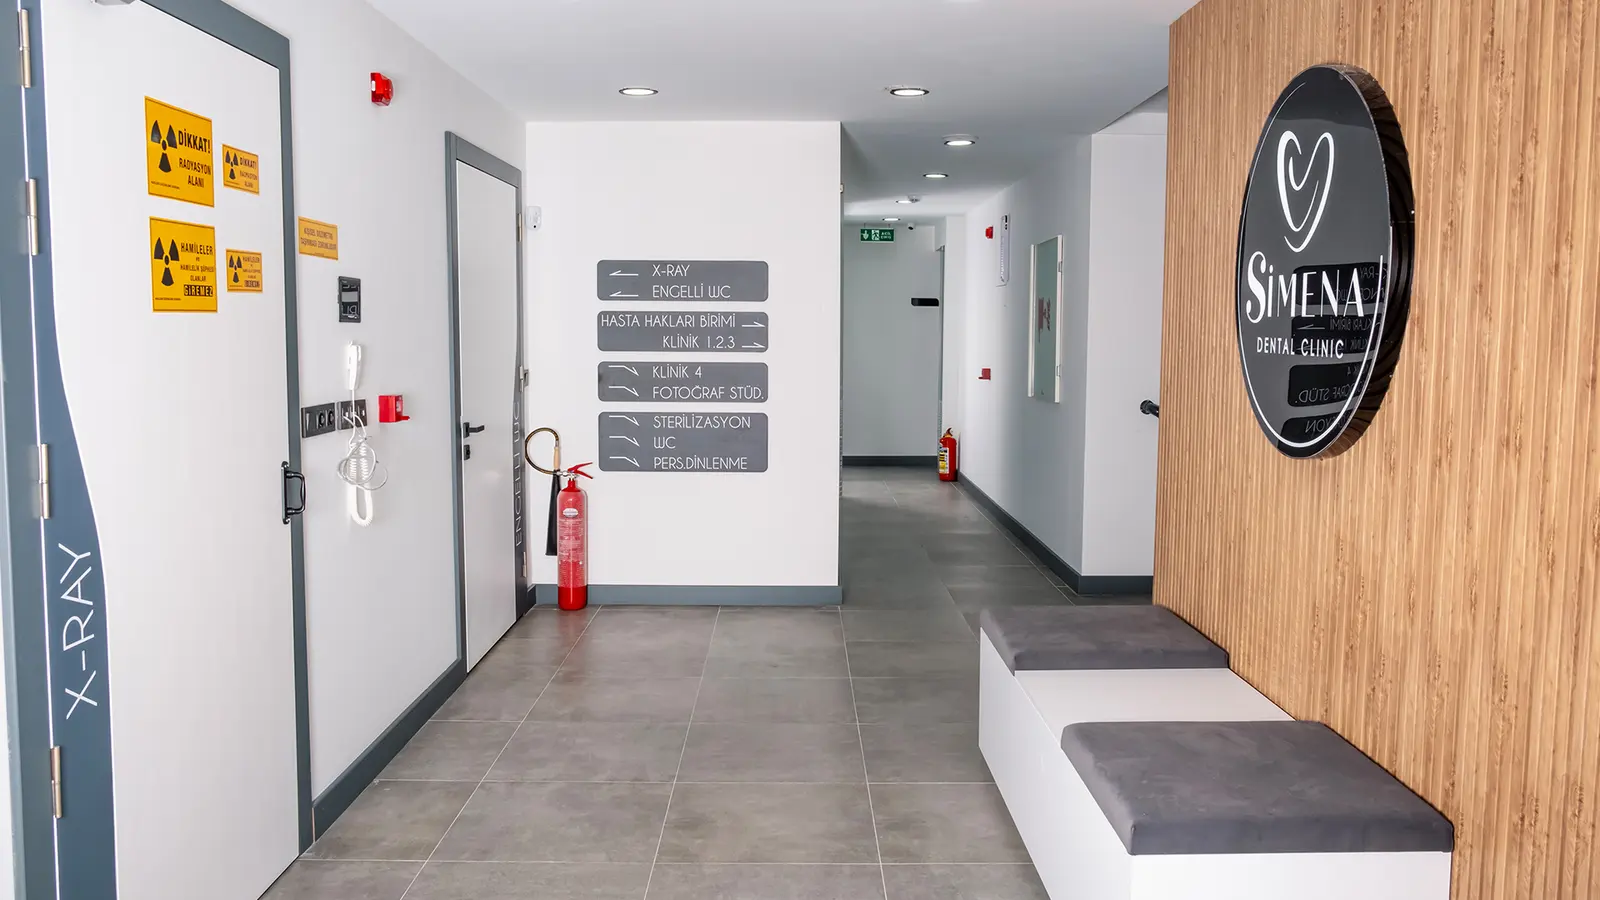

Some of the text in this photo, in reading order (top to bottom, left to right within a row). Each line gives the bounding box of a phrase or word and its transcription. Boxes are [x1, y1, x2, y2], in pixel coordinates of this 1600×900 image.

[178, 128, 211, 154] DİKKAT!
[178, 157, 212, 175] RADYASYON
[187, 174, 205, 189] ALANI
[180, 241, 214, 256] HAMİLELER
[652, 264, 691, 277] X-RAY
[652, 283, 731, 298] ENGELLİ WC
[601, 313, 736, 328] HASTA HAKLARI BİRİMİ
[662, 334, 736, 349] KLİNİK 1.2.3
[1256, 337, 1295, 356] DENTAL
[1300, 338, 1344, 359] CLINIC
[652, 364, 703, 379] KLİNİK 4
[652, 385, 765, 400] FOTOĞRAF STÜD.
[653, 414, 751, 429] STERİLİZASYON
[653, 436, 676, 449] WC
[653, 455, 748, 470] PERS.DİNLENME
[58, 542, 98, 720] X-RAY
